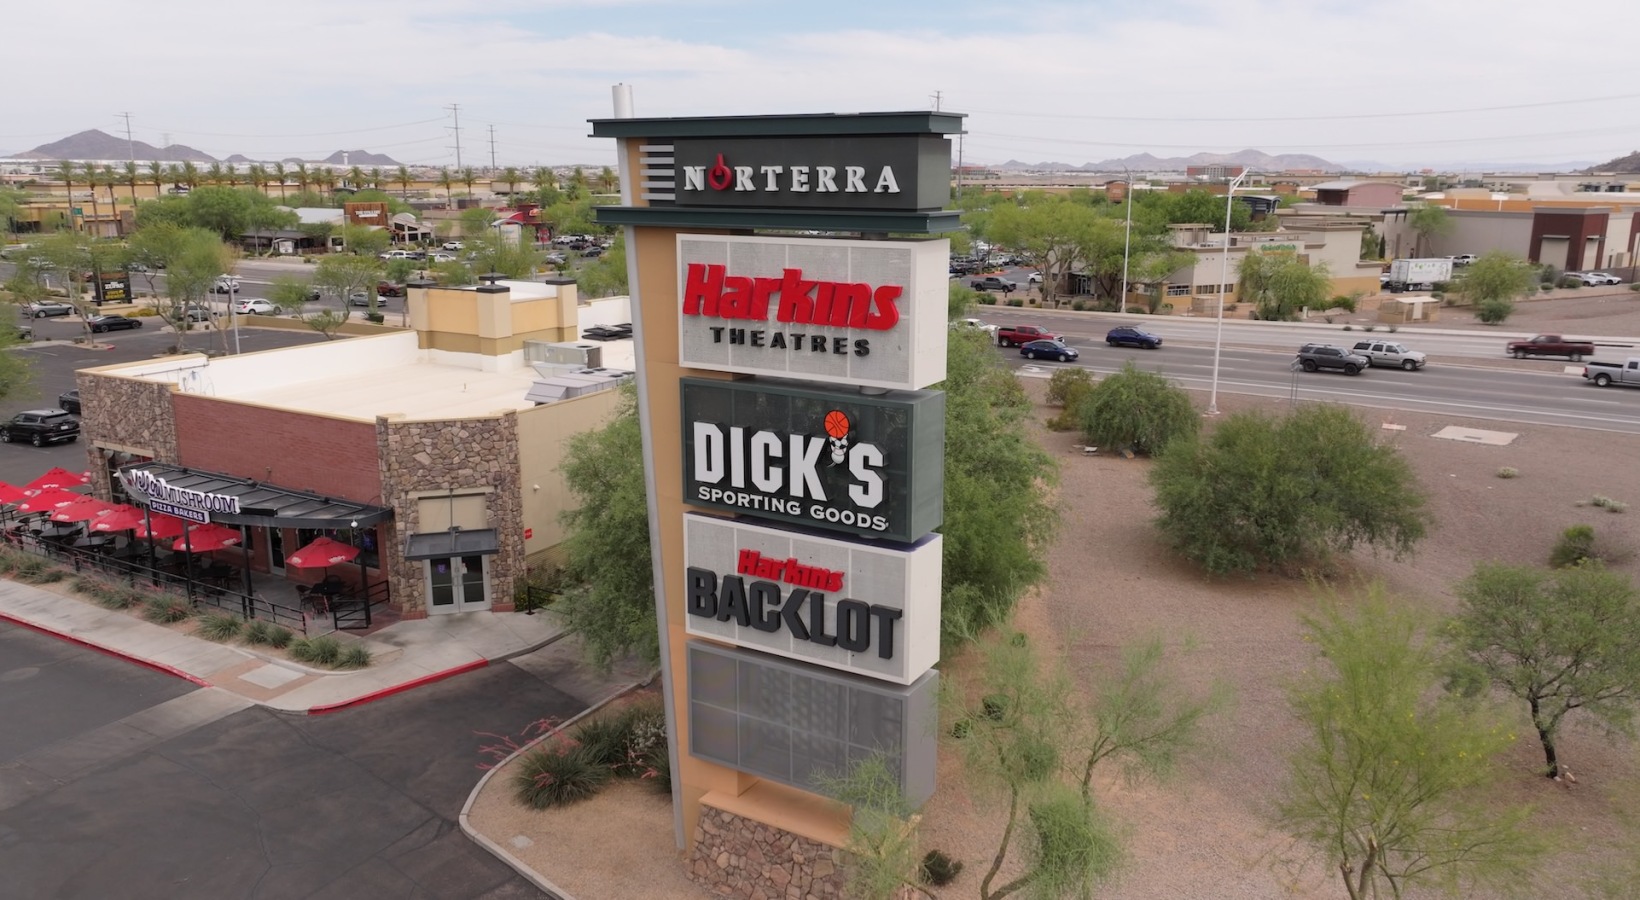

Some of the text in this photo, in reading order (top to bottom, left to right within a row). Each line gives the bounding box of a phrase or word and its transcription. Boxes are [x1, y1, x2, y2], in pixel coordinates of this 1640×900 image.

[683, 153, 901, 193] NORTERRA
[682, 262, 903, 331] Harkins
[709, 326, 871, 357] THEATRES
[693, 410, 890, 509] DICK'S
[152, 501, 204, 521] PIZZA BAKERS
[163, 485, 240, 515] MUSHROOM
[698, 486, 889, 531] SPORTING GOODS
[738, 548, 846, 593] Harkins
[687, 566, 903, 660] BACKLOT
